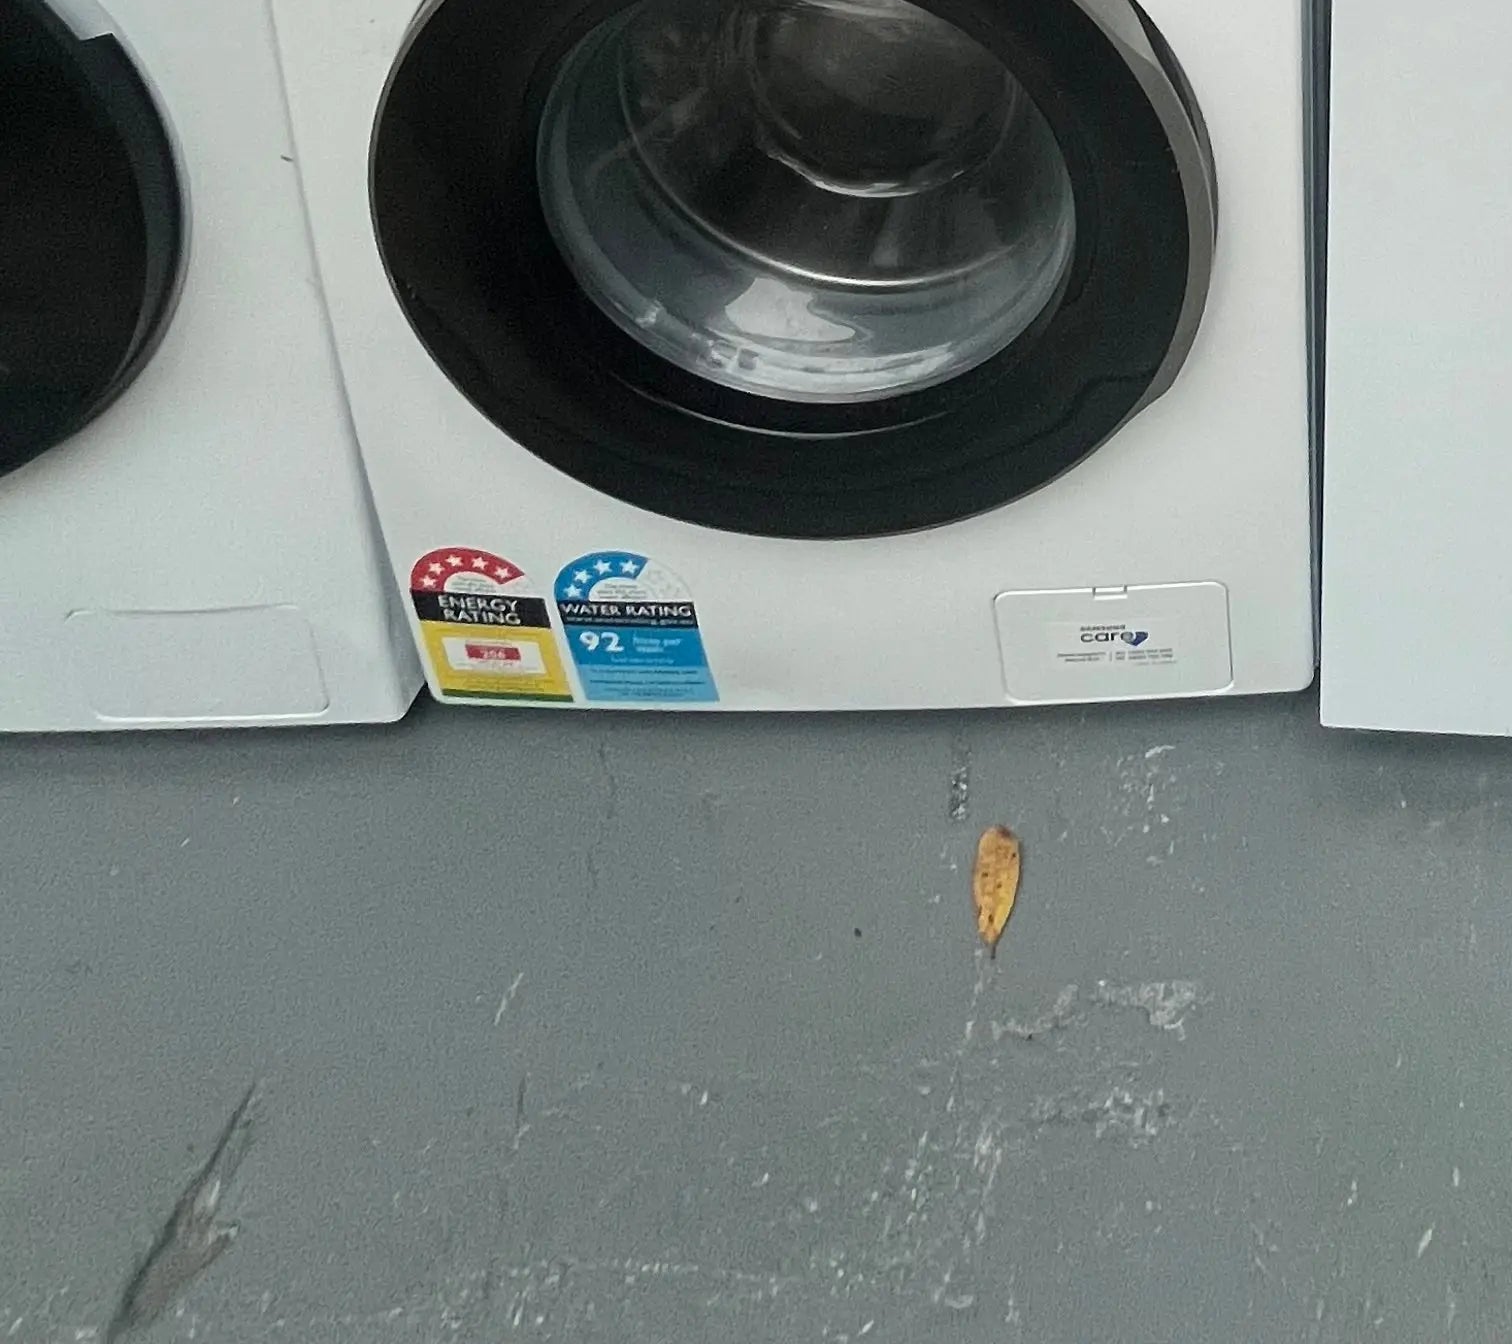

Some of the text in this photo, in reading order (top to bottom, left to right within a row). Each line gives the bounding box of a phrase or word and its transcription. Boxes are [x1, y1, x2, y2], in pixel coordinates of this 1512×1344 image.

[437, 594, 518, 612] ENERGY
[560, 603, 692, 617] WATER RATING
[443, 610, 522, 626] RATING
[578, 630, 625, 653] 92
